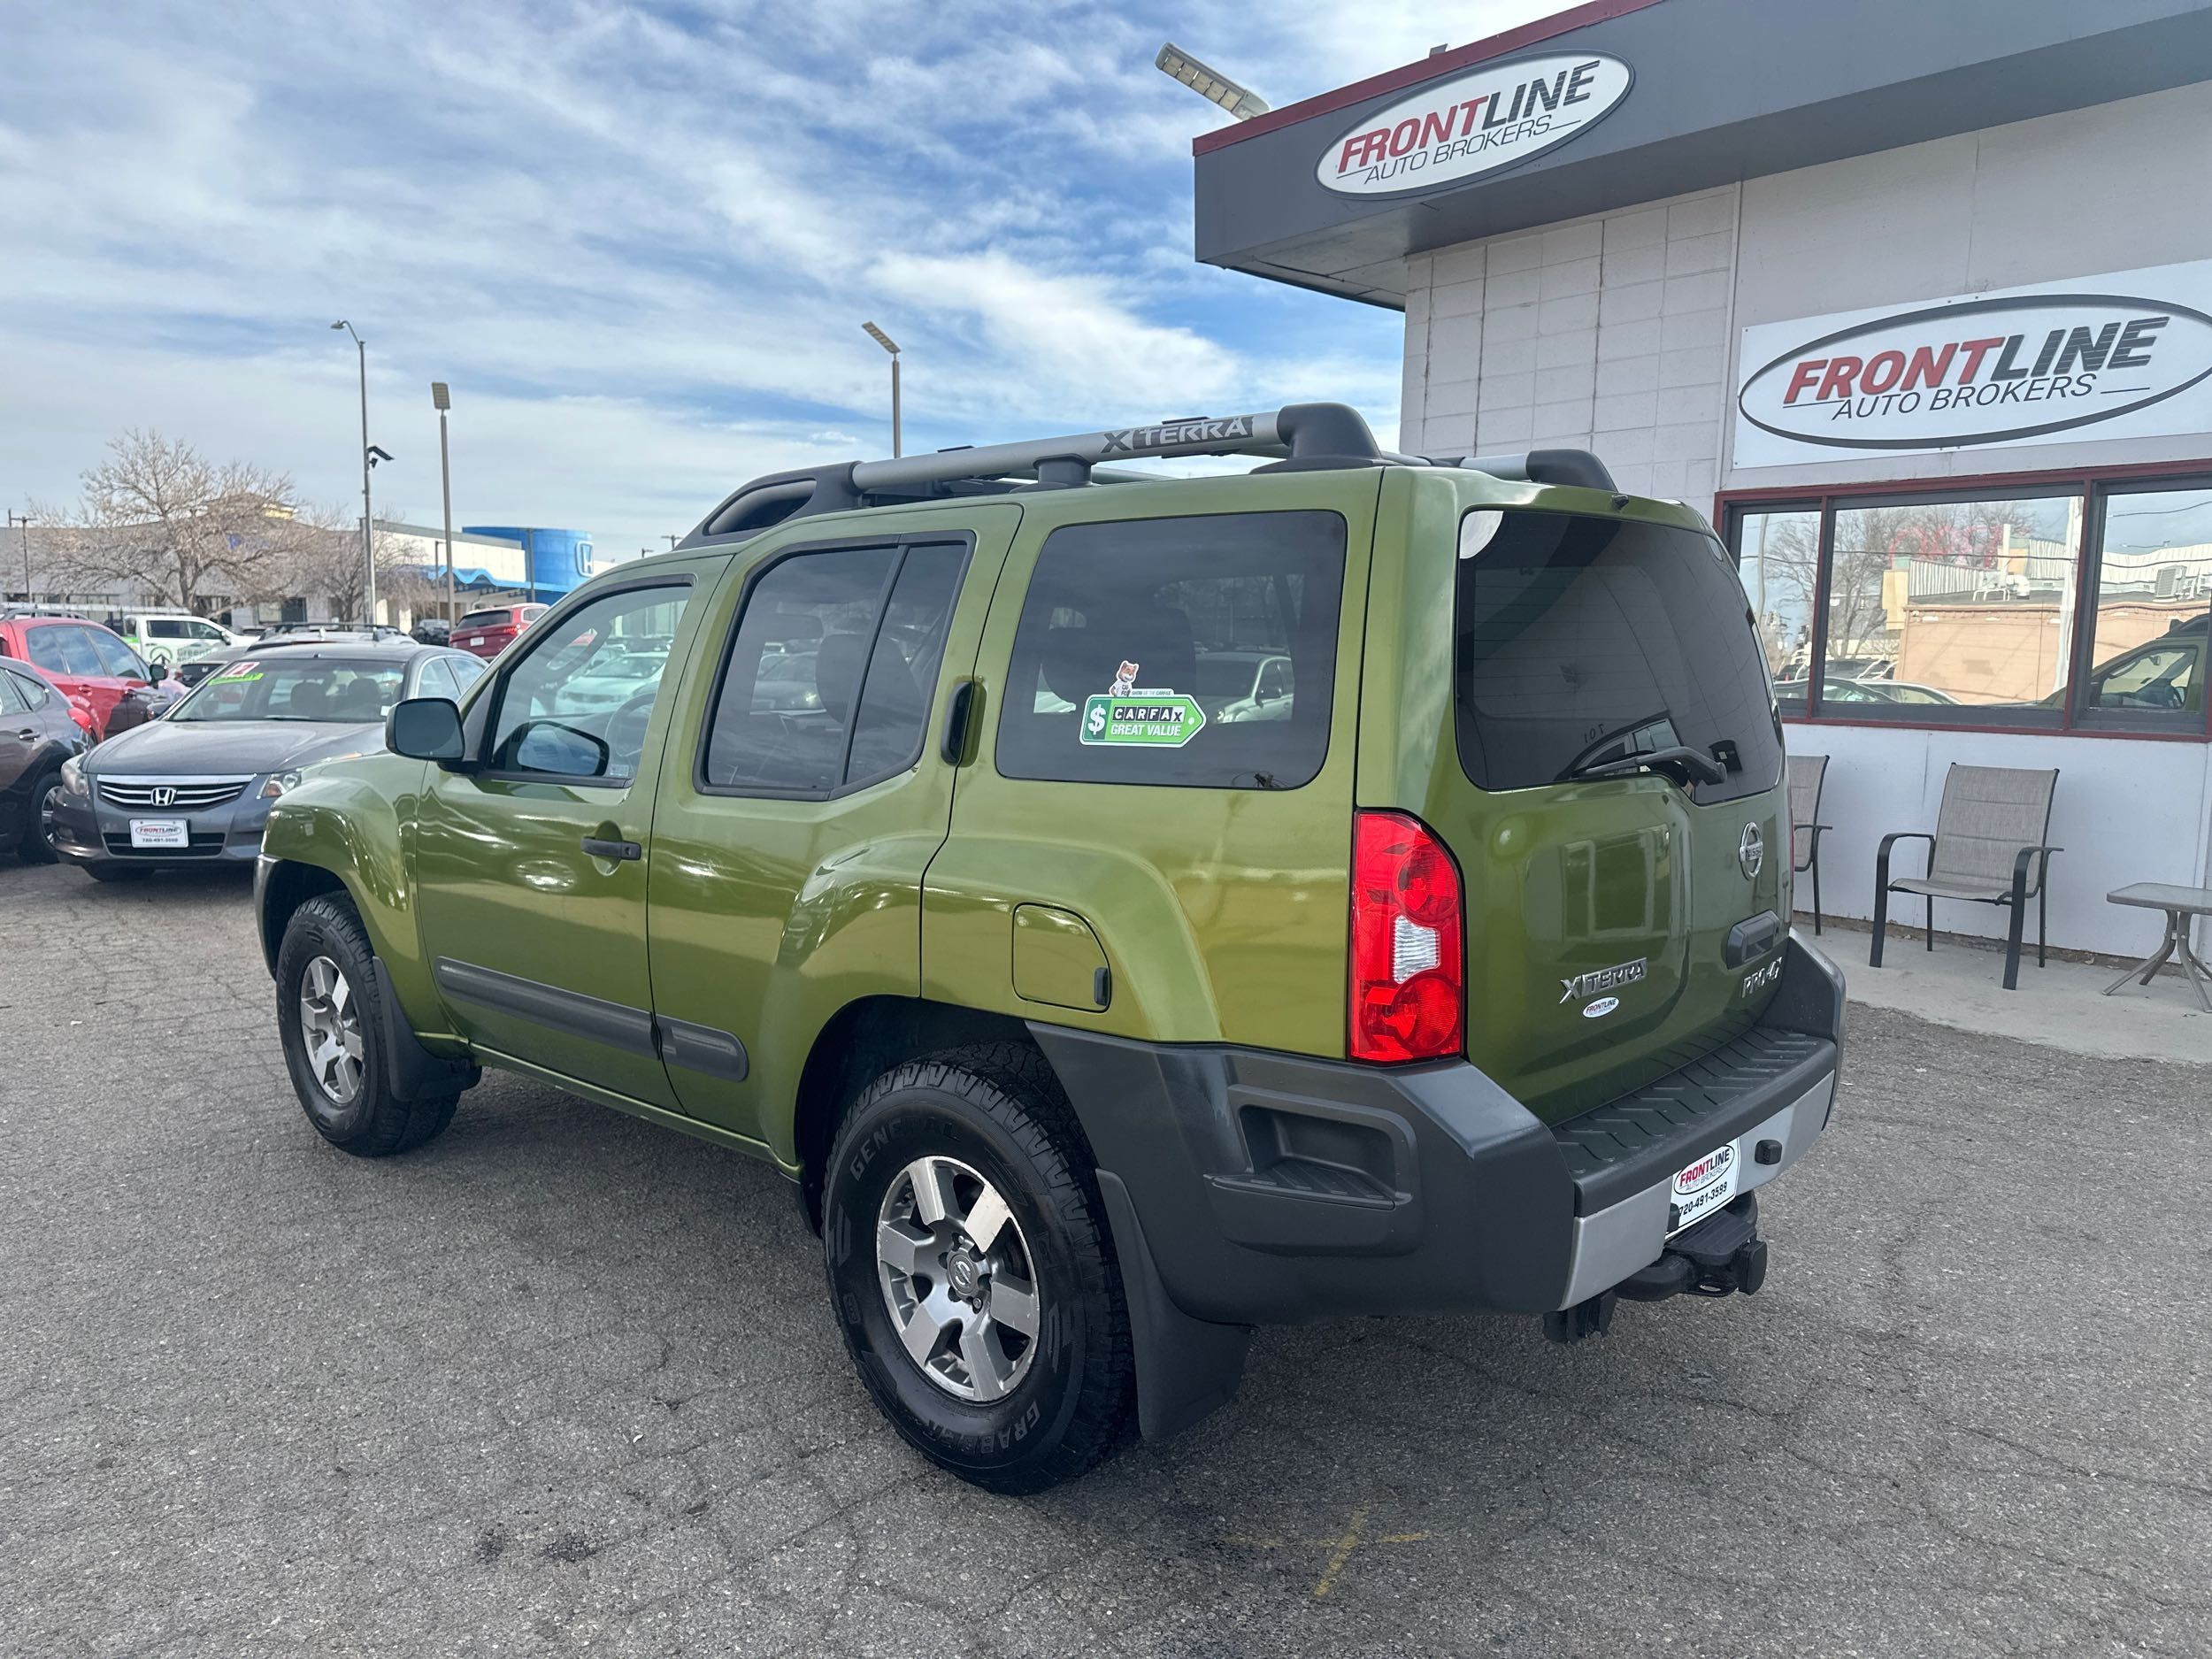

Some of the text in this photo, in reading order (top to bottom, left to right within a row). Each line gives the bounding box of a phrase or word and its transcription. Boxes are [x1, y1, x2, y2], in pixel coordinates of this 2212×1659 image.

[1338, 60, 1601, 174] FRONTLINE
[1364, 114, 1552, 185] AUTO BROKERS
[1783, 316, 2170, 405] FRONTLINE
[1832, 373, 2097, 421] AUTO BROKERS
[1101, 417, 1254, 453] XTERRA
[1110, 724, 1181, 736] GREAT VALUE
[1113, 707, 1184, 722] CARFAX
[1559, 957, 1647, 1004] XTERRA
[1679, 1148, 1730, 1187] FRONTLINE
